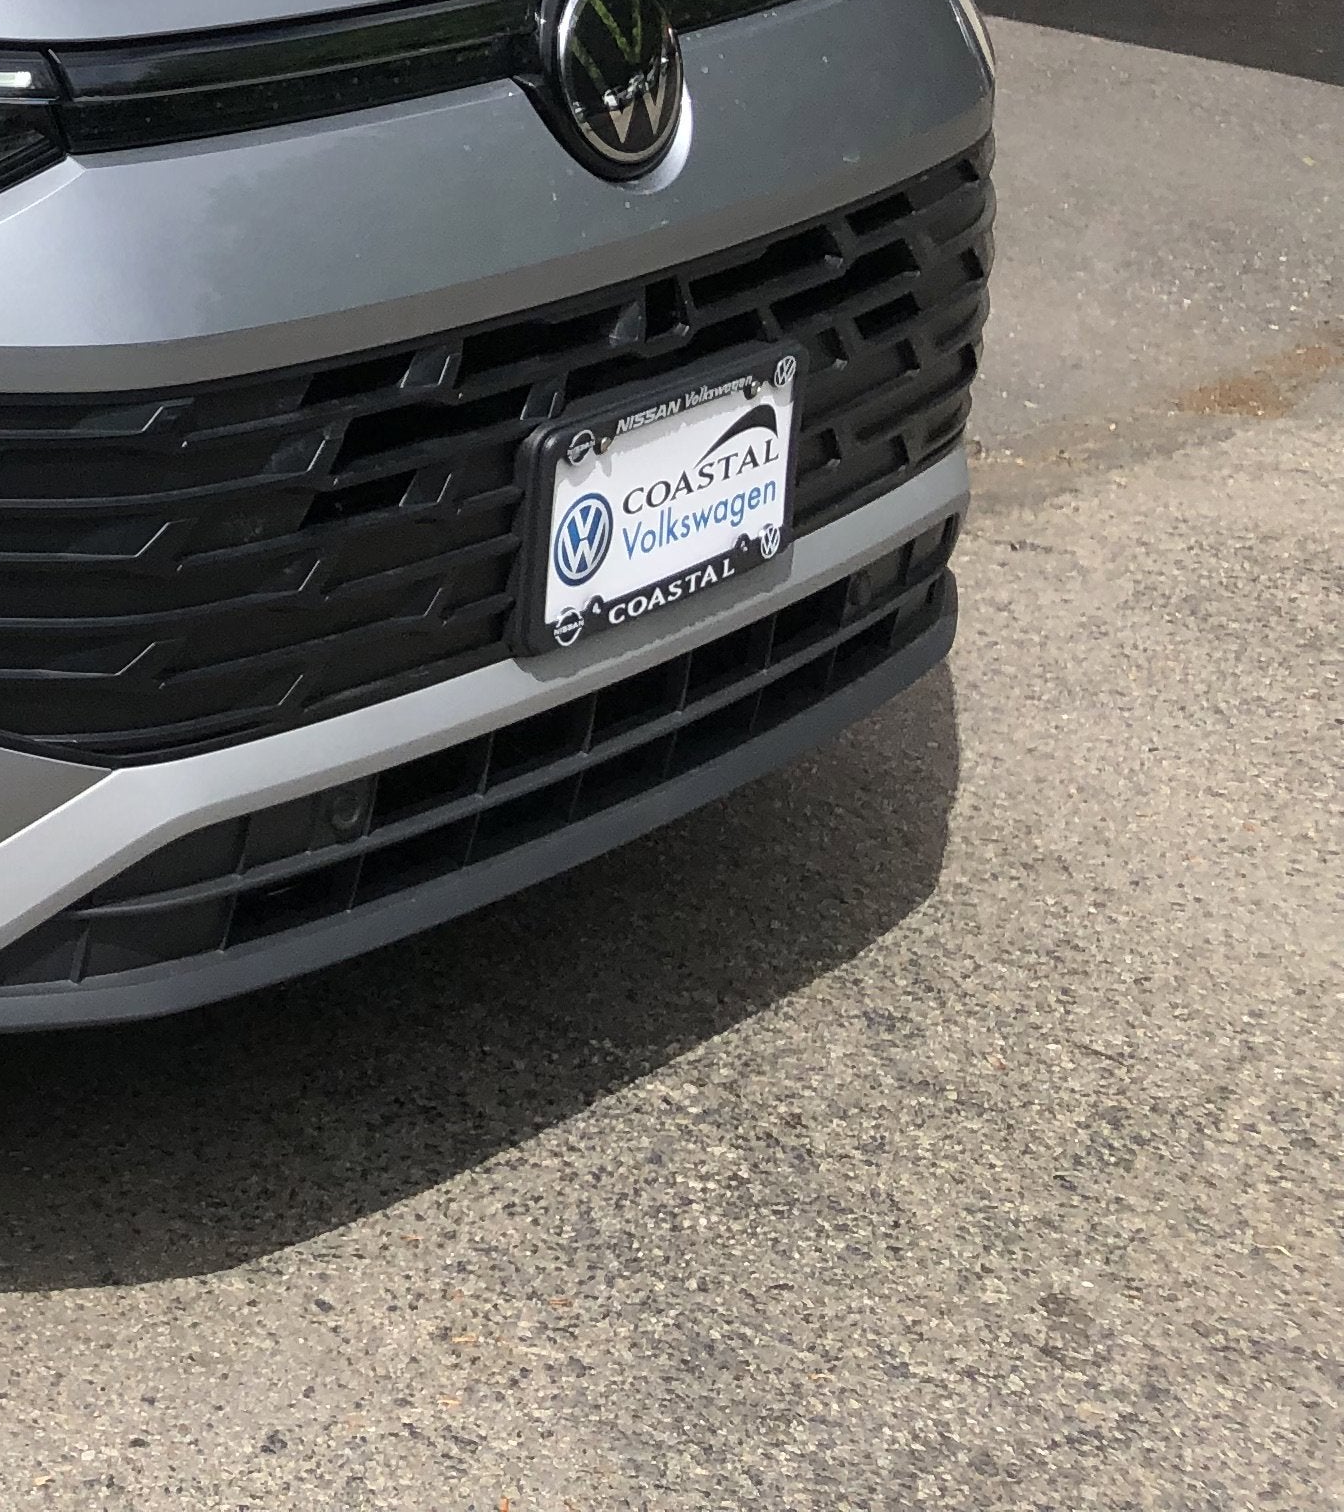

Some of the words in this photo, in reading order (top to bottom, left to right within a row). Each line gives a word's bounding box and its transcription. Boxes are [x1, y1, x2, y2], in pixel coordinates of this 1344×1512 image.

[616, 398, 681, 435] NISSAN
[685, 375, 753, 409] Volkswagen
[623, 439, 779, 515] COASTAL
[623, 480, 776, 560] Volkswagen
[609, 558, 735, 625] COASTAL
